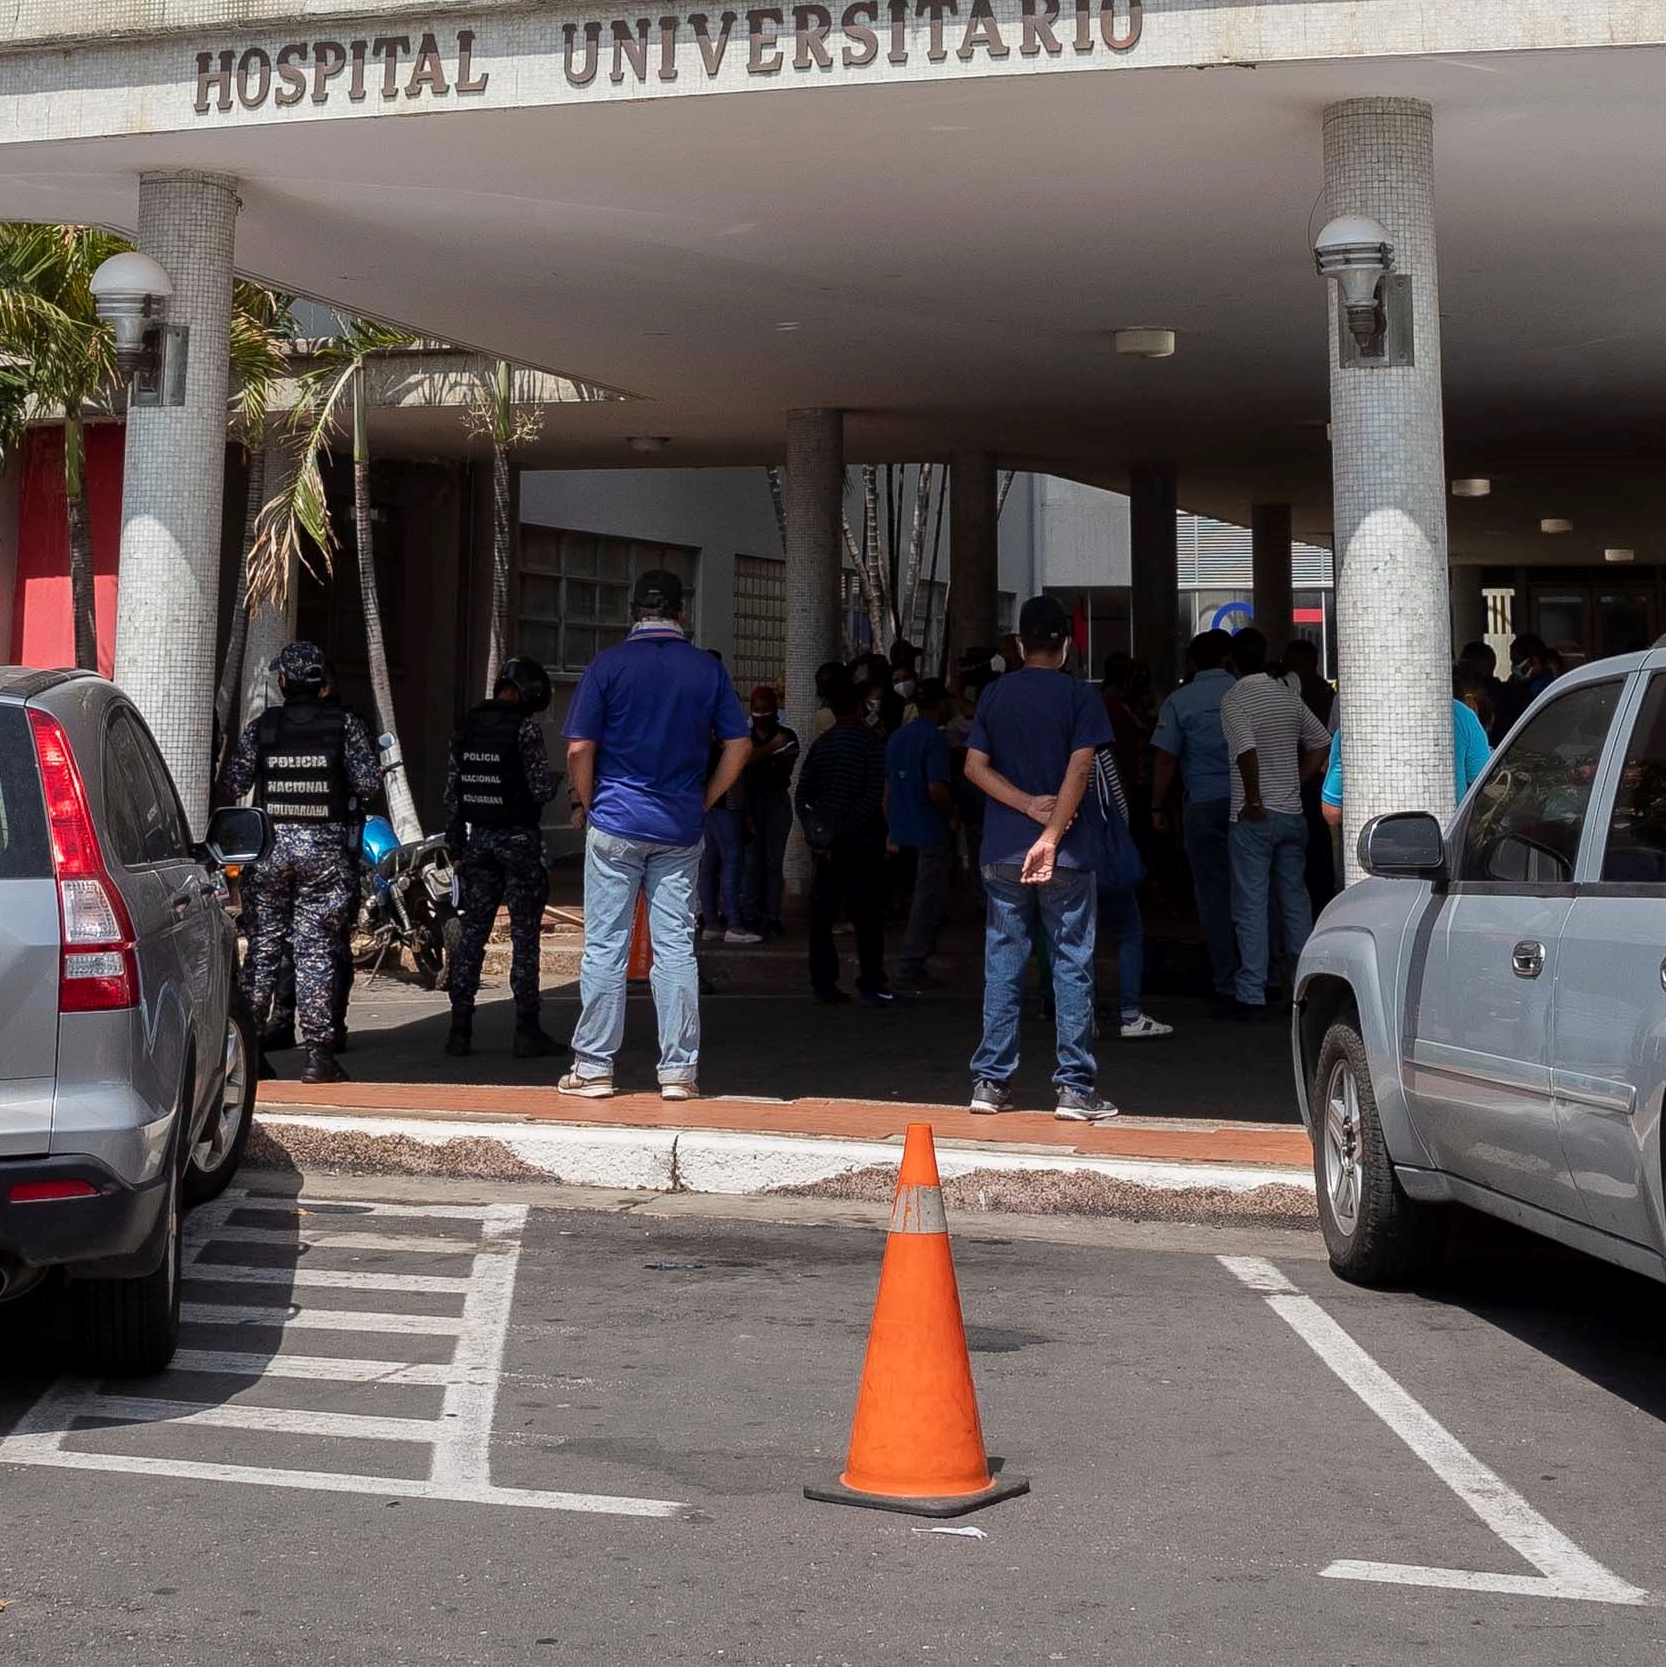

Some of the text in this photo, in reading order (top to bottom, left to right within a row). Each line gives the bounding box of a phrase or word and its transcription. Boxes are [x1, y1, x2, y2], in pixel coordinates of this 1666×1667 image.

[194, 30, 489, 114] HOSPITAL
[268, 755, 327, 768] POLICIA
[463, 752, 500, 762] POLICIA
[267, 781, 330, 792] NACIONAL
